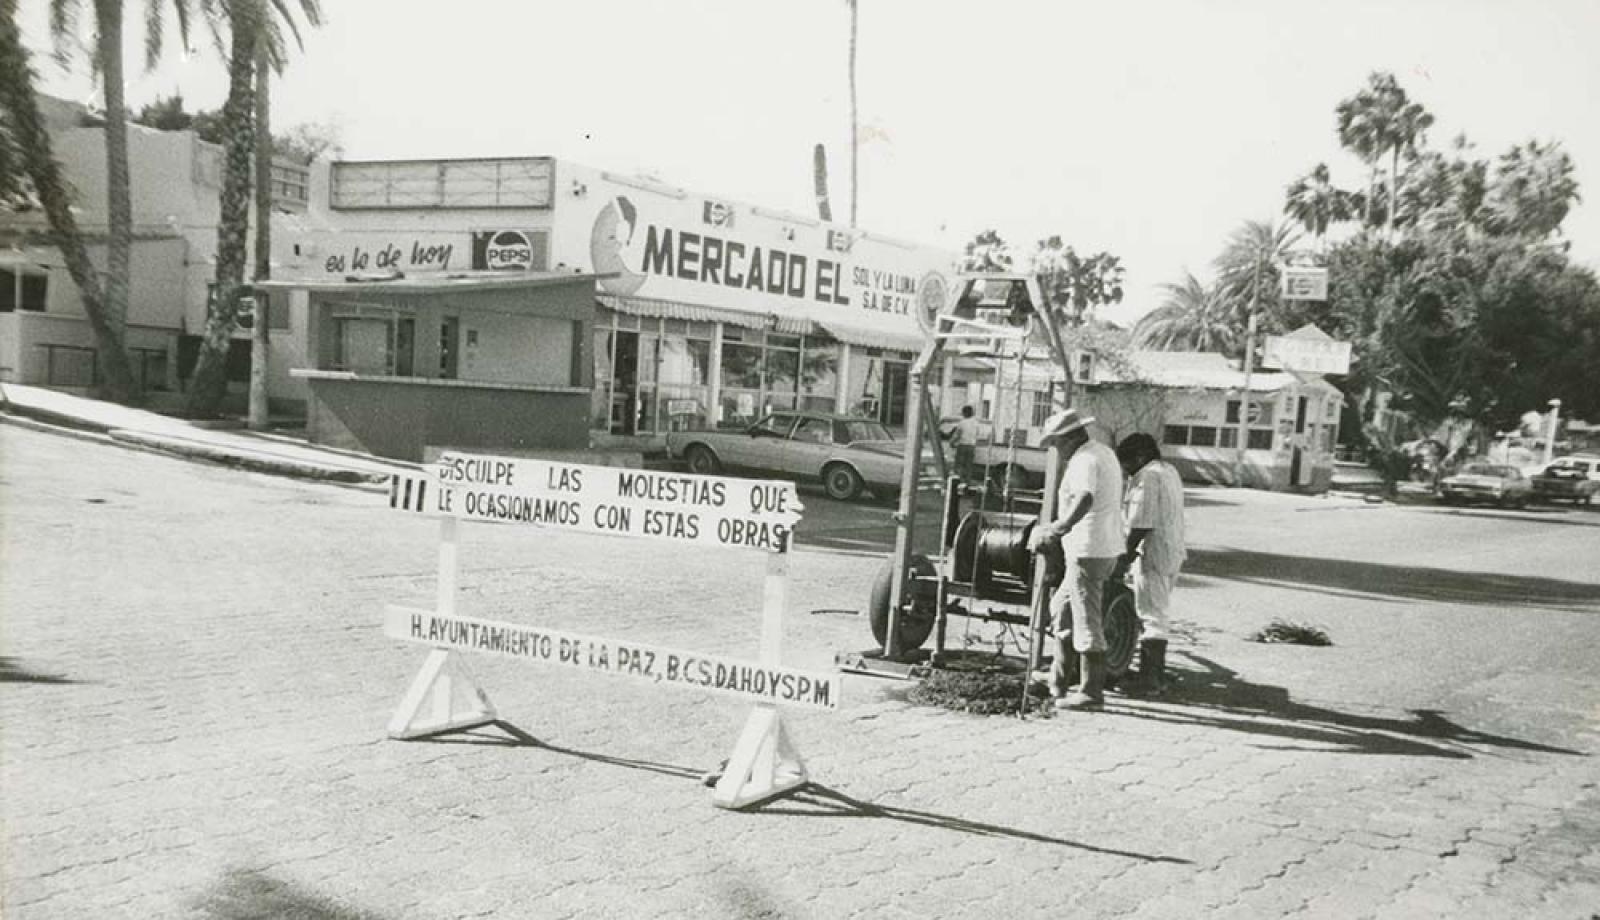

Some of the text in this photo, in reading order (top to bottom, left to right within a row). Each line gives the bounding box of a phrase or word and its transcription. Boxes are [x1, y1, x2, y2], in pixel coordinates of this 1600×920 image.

[325, 239, 452, 272] es lo de hoy
[488, 248, 532, 262] PEPSI
[642, 224, 849, 305] MERCADO EL
[853, 266, 870, 287] SOL
[882, 295, 893, 313] DE
[439, 455, 788, 513] DISCULPE LAS MOLESTIAS QUE
[438, 488, 787, 550] LE OCASIONAMOS CON ESTAS OBRAS
[559, 637, 580, 665] DE
[589, 642, 609, 669] LA
